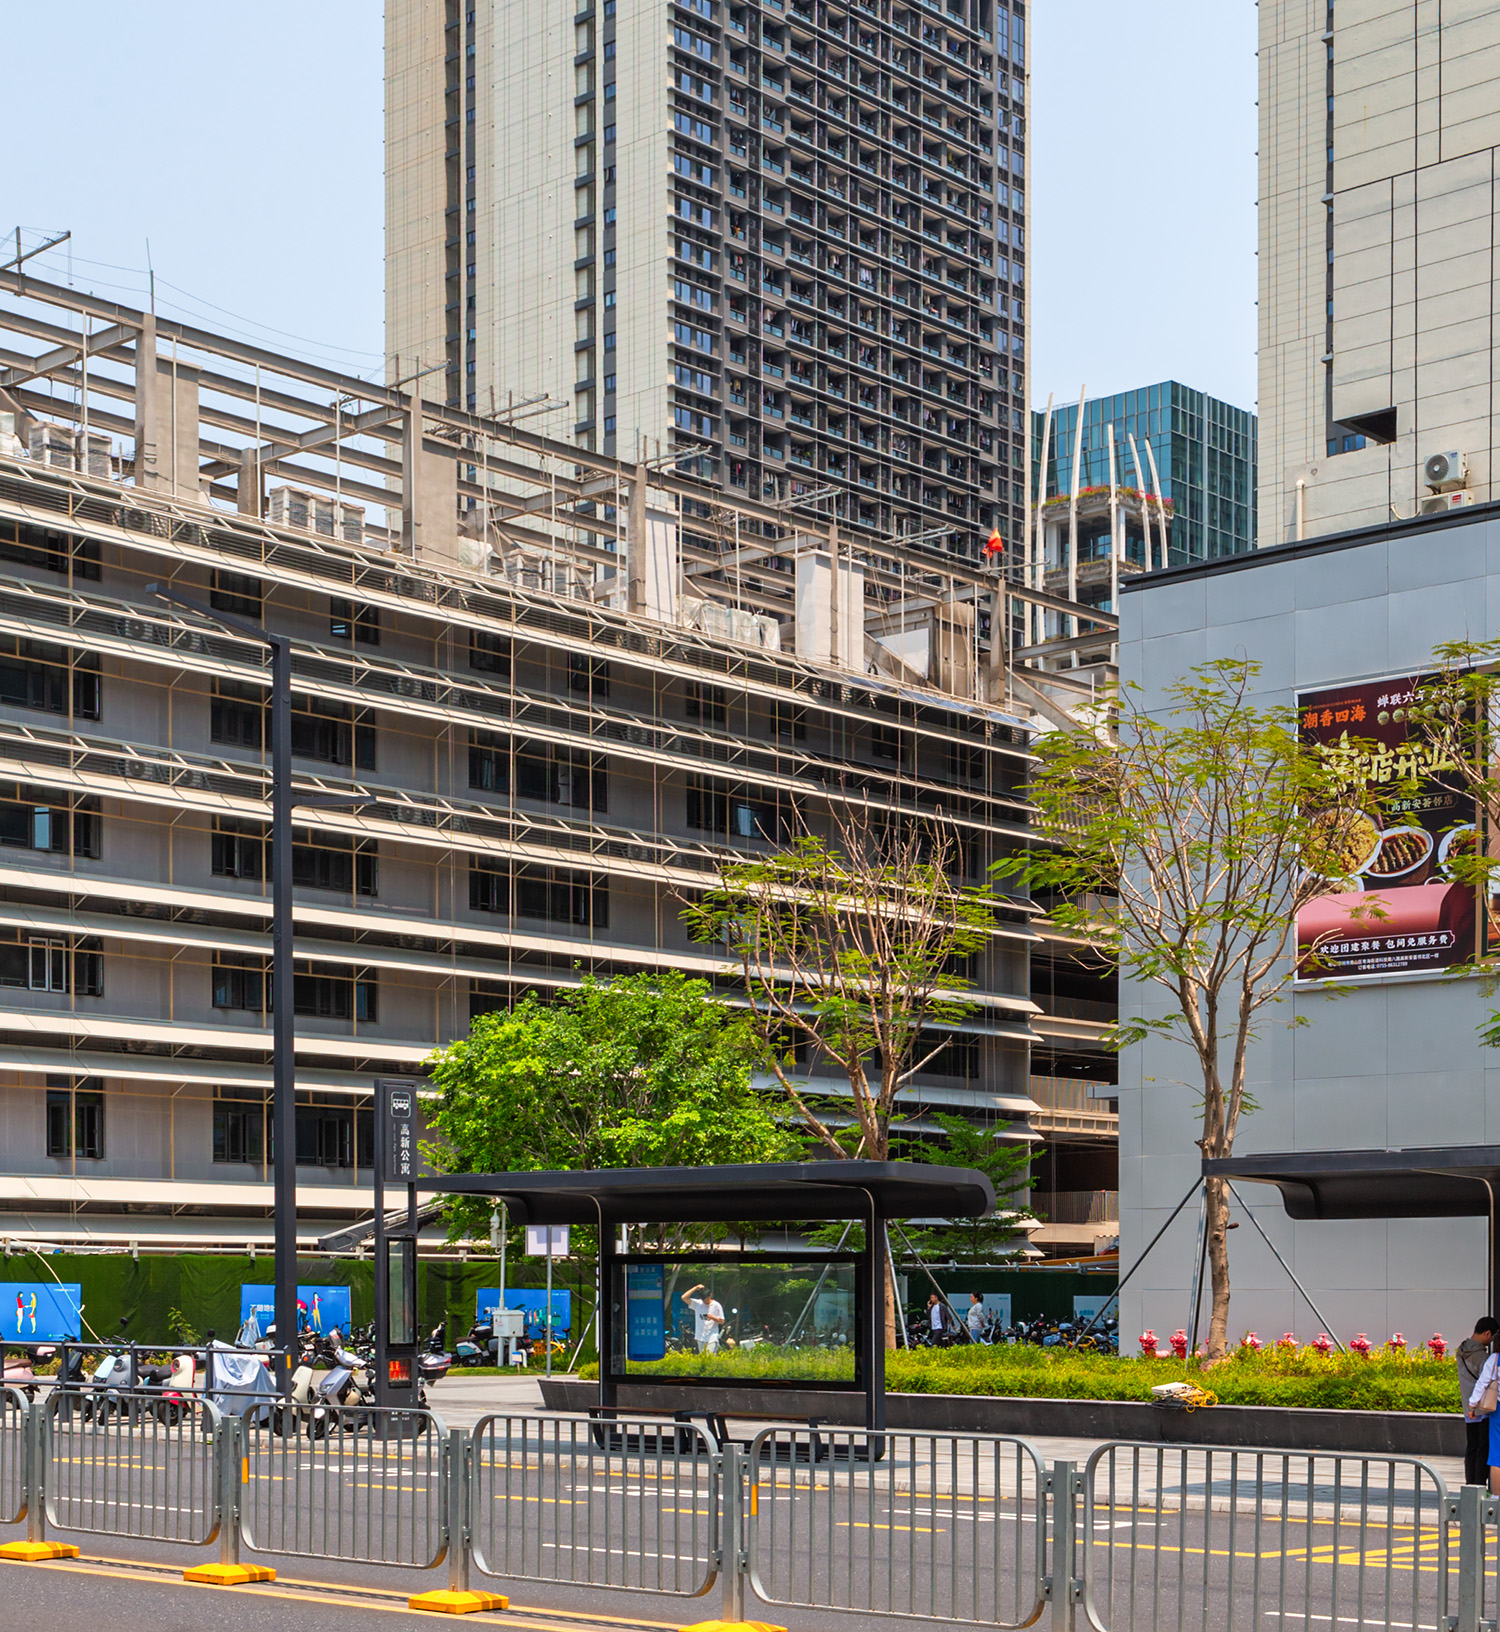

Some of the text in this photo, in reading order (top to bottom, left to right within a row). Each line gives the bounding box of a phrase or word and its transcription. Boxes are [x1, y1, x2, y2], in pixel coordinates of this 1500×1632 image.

[1302, 704, 1367, 729] 潮香四海
[1320, 940, 1381, 954] 欢迎团建聚餐
[400, 1123, 411, 1175] 高新公寓
